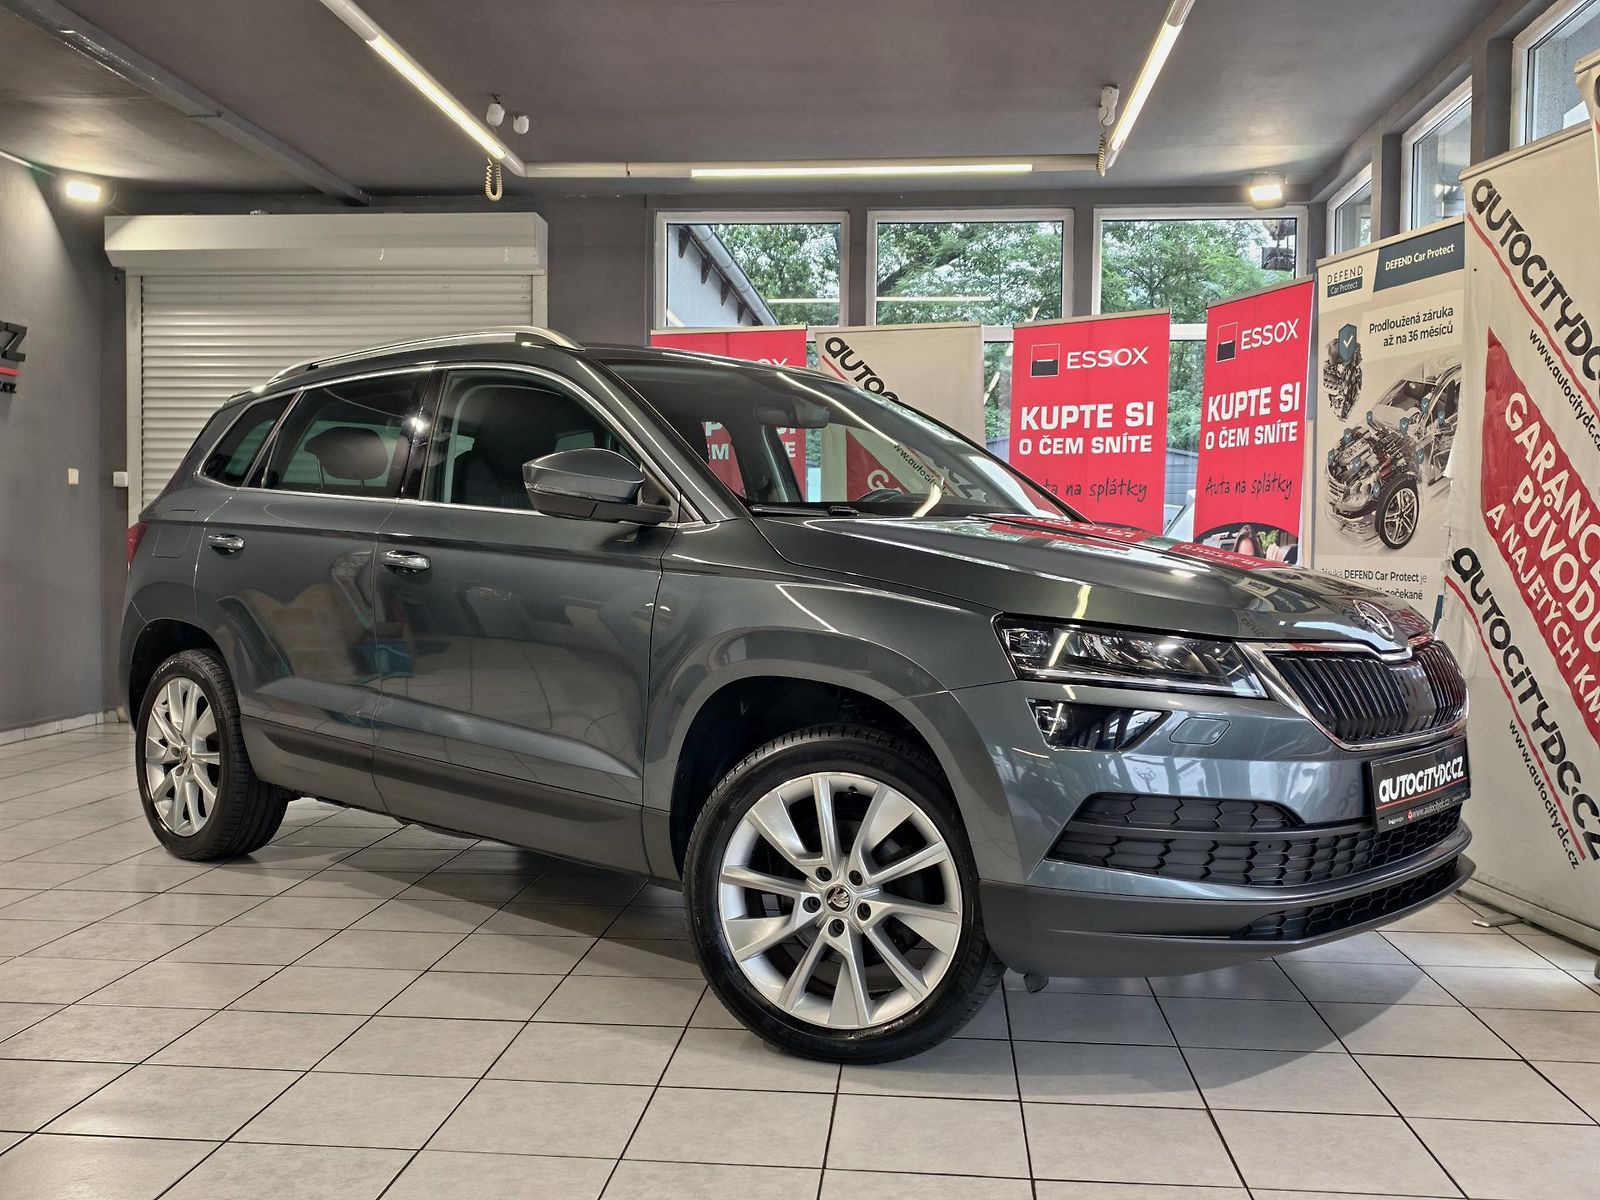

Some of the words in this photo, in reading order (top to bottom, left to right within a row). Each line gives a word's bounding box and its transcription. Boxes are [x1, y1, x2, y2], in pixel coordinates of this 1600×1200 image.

[1385, 255, 1412, 271] DEFEND
[1413, 252, 1426, 263] Car
[1427, 243, 1455, 259] Protect
[1326, 265, 1363, 285] DEFEND
[1330, 286, 1340, 294] Car
[1340, 281, 1358, 291] Protect
[1369, 311, 1421, 334] Prodloužená
[1422, 306, 1454, 322] záruka
[1383, 334, 1394, 347] až
[1396, 334, 1407, 345] na
[1408, 329, 1419, 342] 36
[1420, 320, 1453, 340] měsíců
[1241, 318, 1300, 351] ESSOX
[1066, 347, 1149, 369] ESSOX
[1020, 403, 1113, 430] KUPTE
[1125, 401, 1154, 428] SI
[1206, 386, 1272, 422] KUPTE
[1279, 381, 1301, 413] SI
[1019, 438, 1032, 455] O
[1038, 435, 1084, 455] ČEM
[1091, 431, 1153, 455] SNÍTE
[1205, 432, 1214, 451] O
[1218, 427, 1249, 449] ČEM
[1254, 421, 1298, 446] SNÍTE
[1066, 483, 1081, 496] na
[1089, 477, 1147, 503] splátky
[1205, 475, 1230, 496] Auta
[1235, 480, 1247, 494] na
[1250, 472, 1292, 501] splátky
[1344, 569, 1374, 580] DEFEND
[1374, 571, 1388, 581] Car
[1390, 571, 1419, 583] Protect
[1420, 572, 1427, 585] je
[1486, 503, 1507, 530] A
[1501, 523, 1580, 668] NAJETÝCH
[1509, 720, 1580, 870] www.autocitydc.cz
